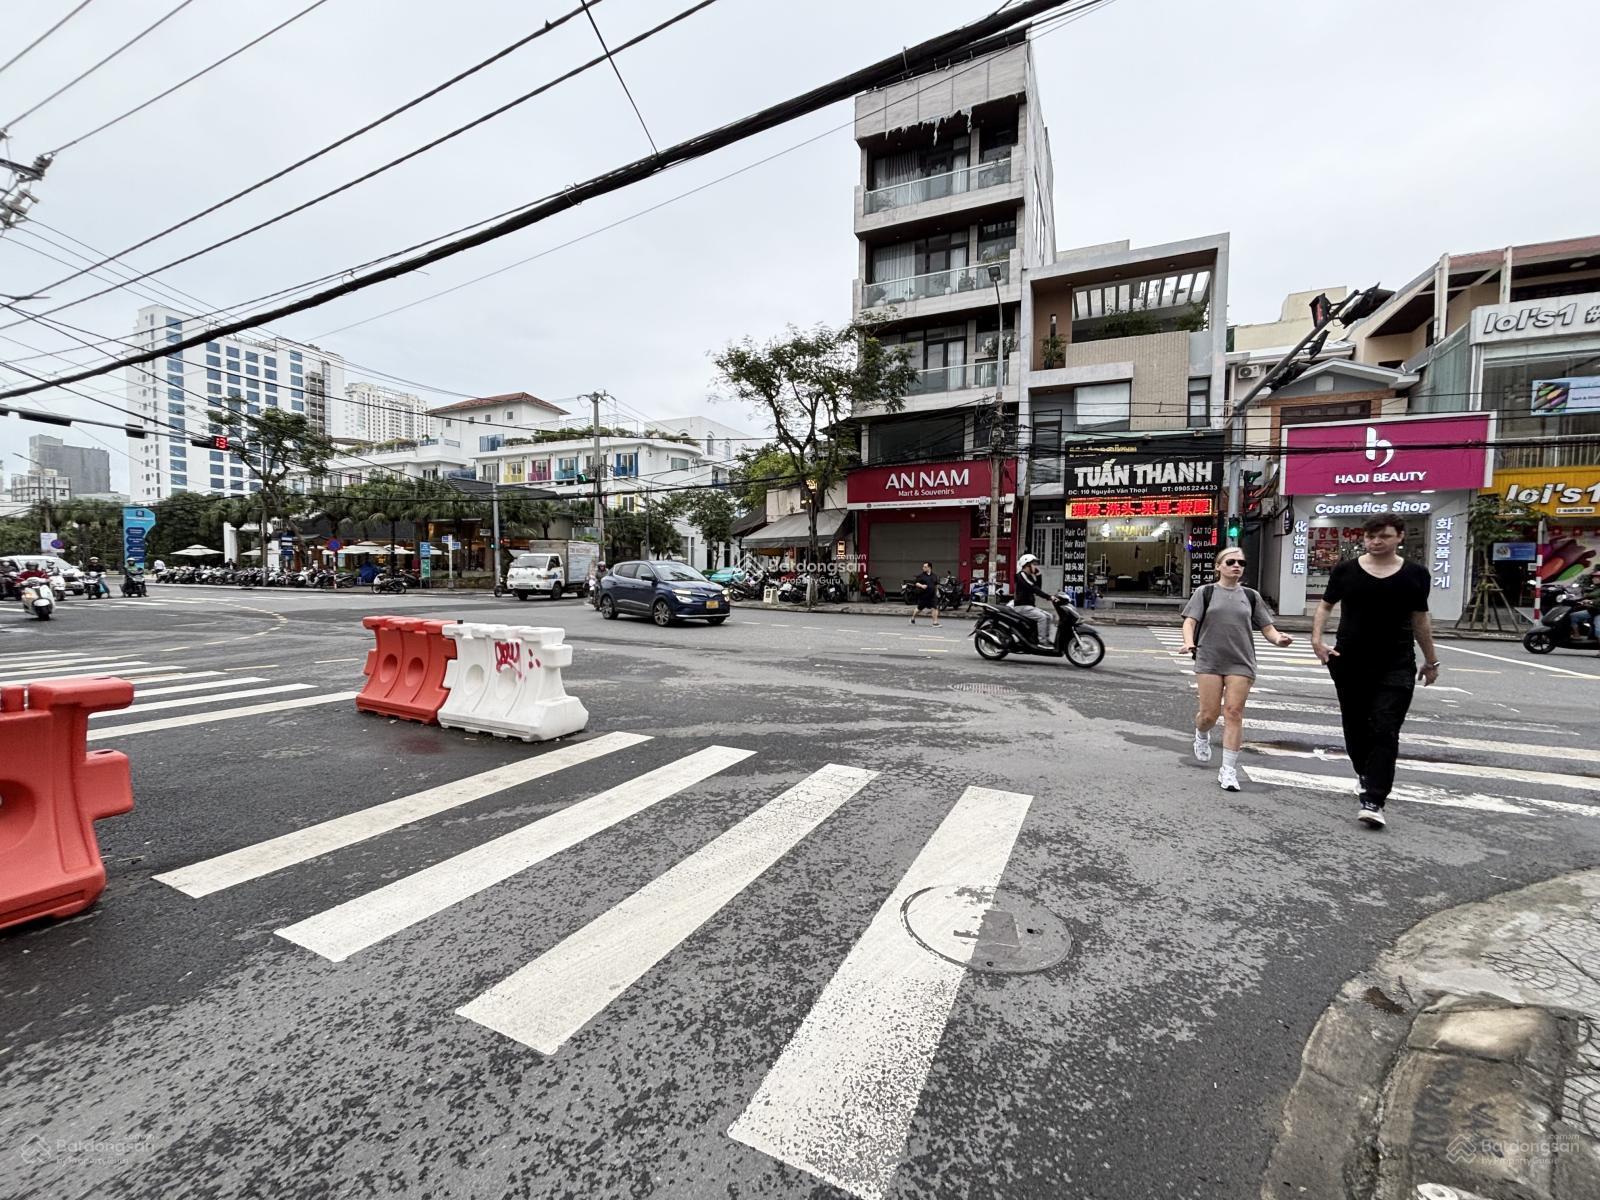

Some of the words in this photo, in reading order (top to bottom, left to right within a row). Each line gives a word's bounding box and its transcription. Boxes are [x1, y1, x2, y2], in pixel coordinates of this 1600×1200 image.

[885, 471, 915, 490] AN
[919, 468, 969, 488] NAM
[1074, 458, 1130, 487] TUẤN
[1133, 461, 1213, 485] THANH
[1335, 474, 1369, 484] HADI
[1373, 471, 1427, 482] BEAUTY
[898, 489, 913, 497] Mart
[920, 488, 955, 496] Souvenirs
[1091, 487, 1115, 496] Nguyễn
[1315, 502, 1388, 514] Cosmetics
[1391, 501, 1431, 513] Shop
[1065, 528, 1075, 536] Hair
[1076, 528, 1086, 536] Cut
[1064, 540, 1073, 548] Hair
[1293, 520, 1307, 574] 化妆品店
[1064, 551, 1073, 559] Hair
[1073, 551, 1085, 559] Color
[1433, 517, 1454, 589] 화장품가게
